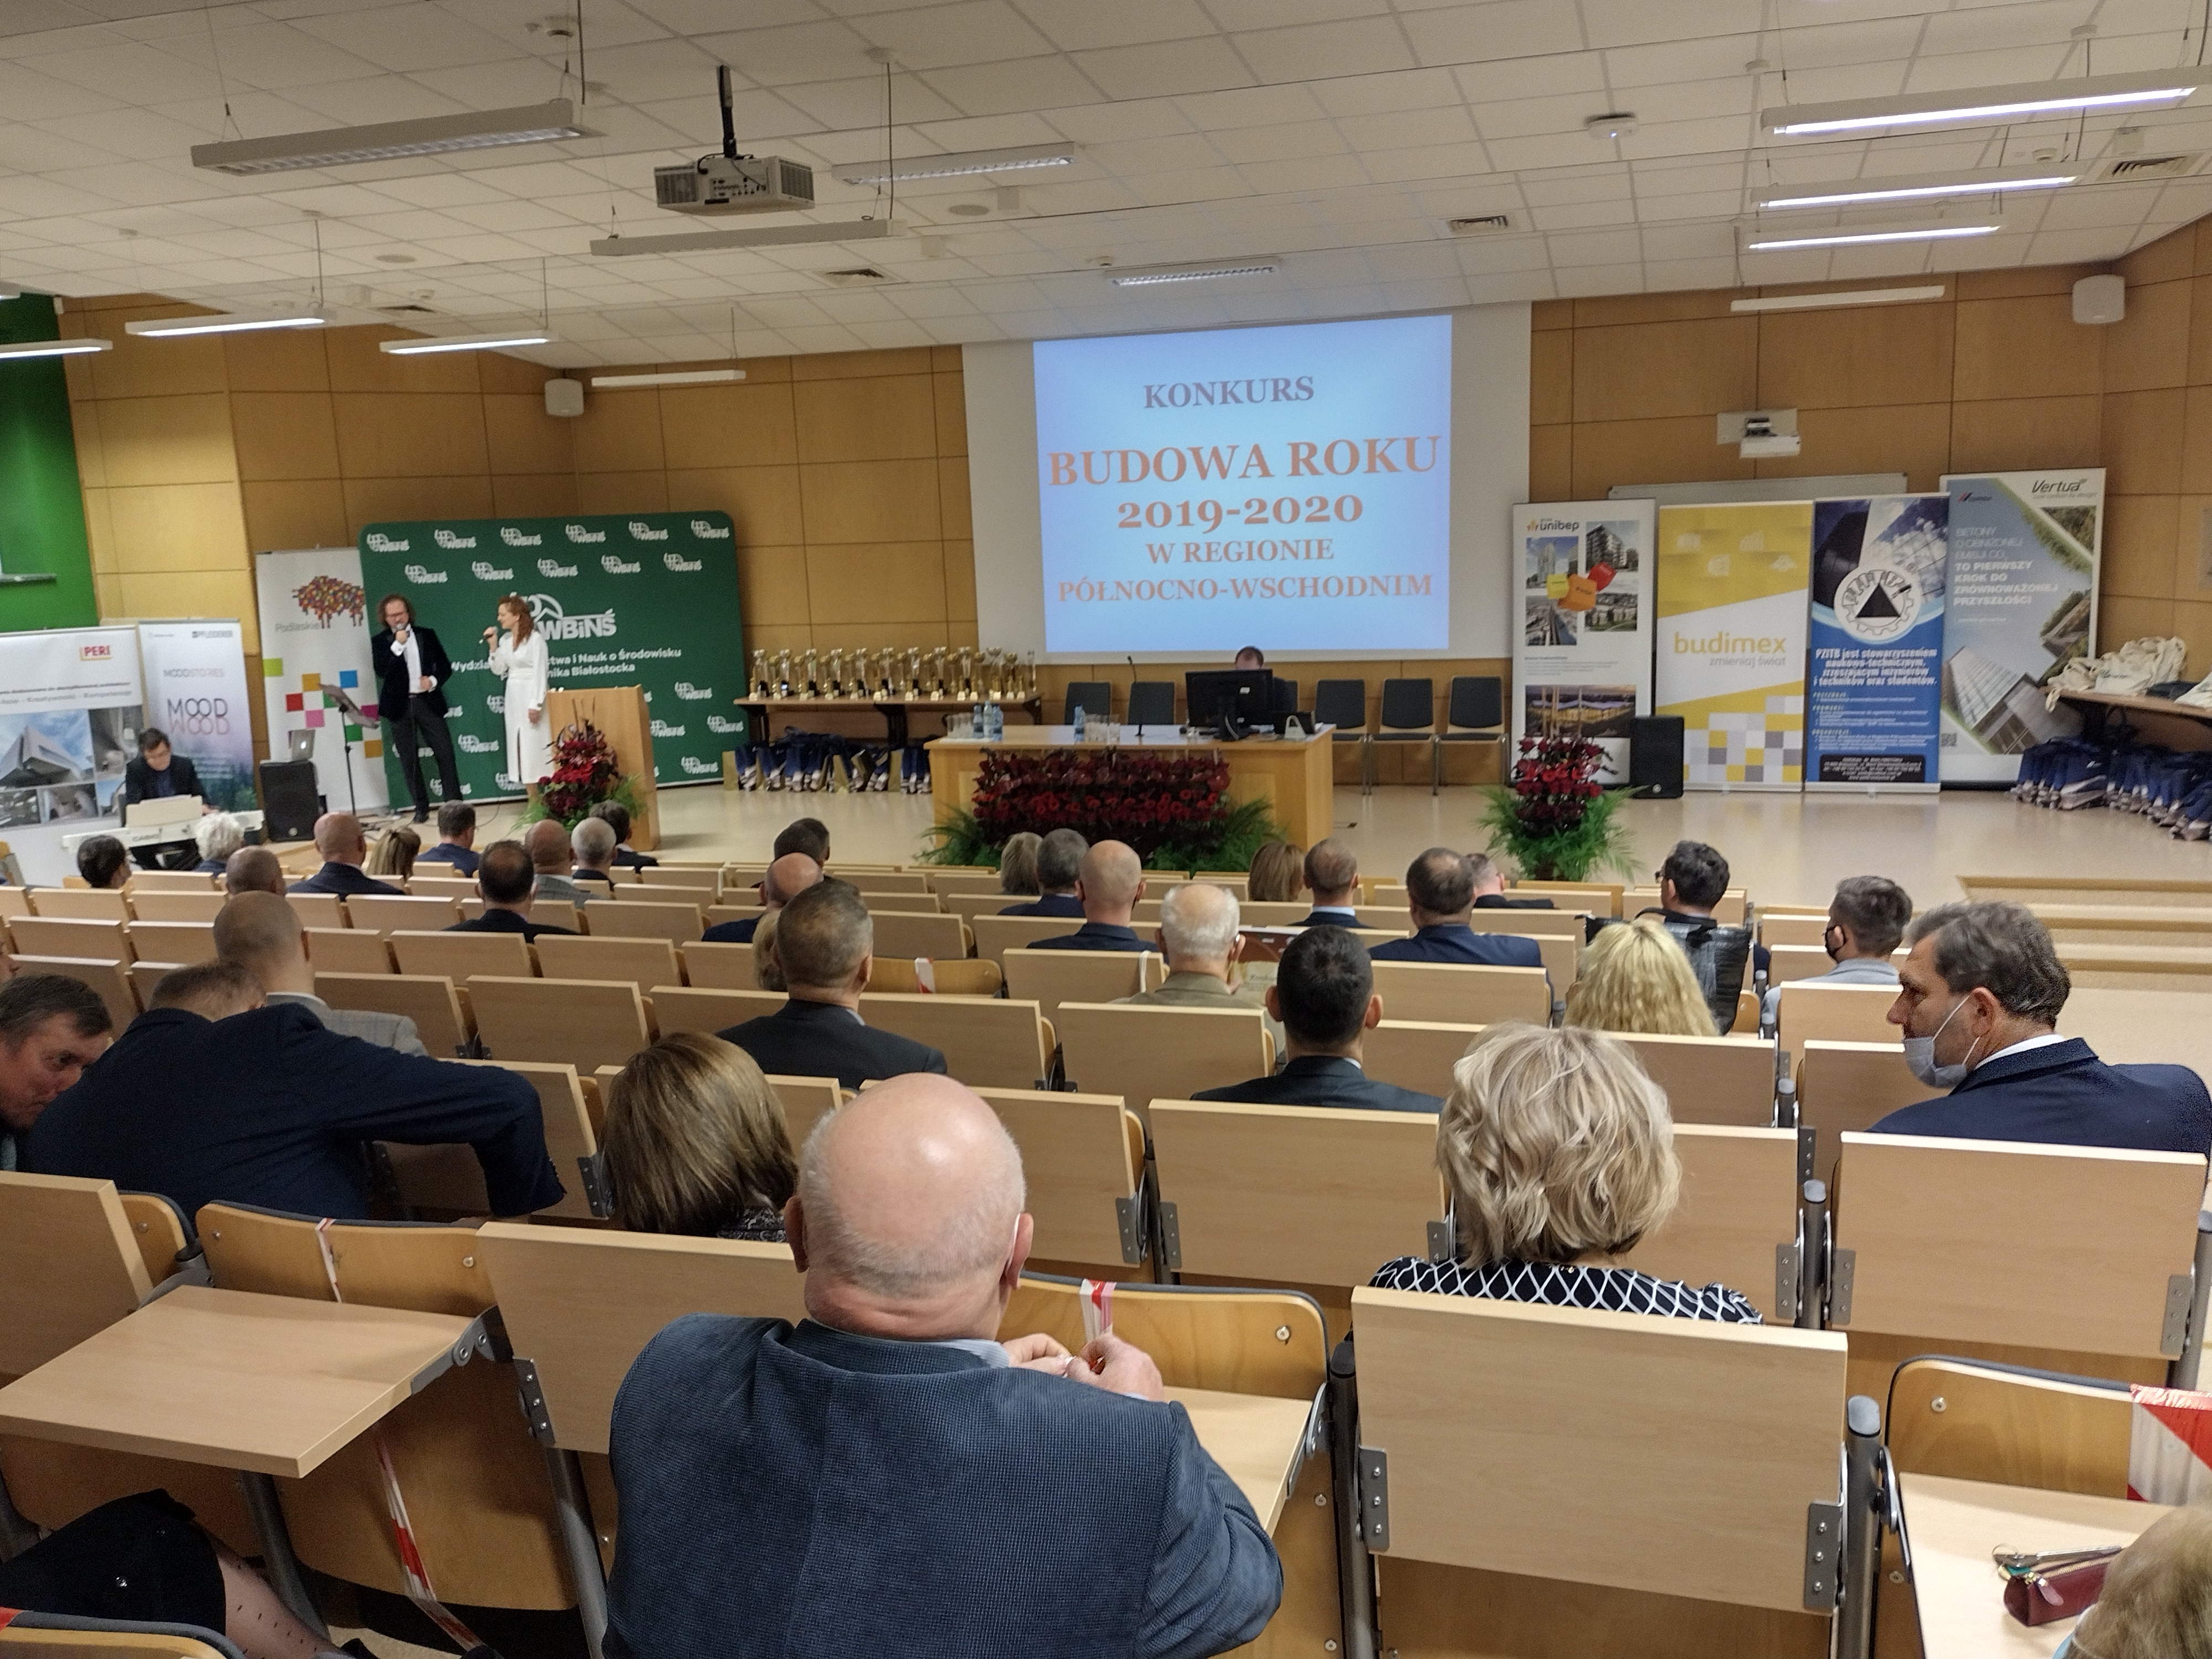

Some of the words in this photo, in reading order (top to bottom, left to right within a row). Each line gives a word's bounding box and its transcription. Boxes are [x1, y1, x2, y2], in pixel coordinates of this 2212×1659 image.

[1144, 376, 1314, 408] KONKURS
[1047, 444, 1275, 486] BUDOWA
[1286, 435, 1442, 477] ROKU
[2031, 479, 2081, 493] Vertua
[1118, 495, 1363, 534] 2019-2020
[1540, 520, 1579, 532] unibep
[1145, 542, 1176, 564] W
[1183, 538, 1334, 563] REGIONIE
[1954, 562, 1971, 571] TO
[1973, 560, 2034, 571] PIERWSZY
[1058, 573, 1433, 602] PÓŁNOCNO-WSCHODNIM
[1954, 573, 1988, 583] KROK
[1990, 572, 2008, 582] DO
[537, 608, 617, 640] WBiNŚ
[84, 645, 110, 656] PERI
[1673, 630, 1786, 654] budimex
[451, 659, 490, 672] Wydzia
[578, 651, 607, 664] Nauk
[609, 653, 617, 661] o
[618, 648, 682, 661] Środowisku
[1815, 648, 1840, 659] PZITB
[1842, 648, 1860, 660] jest
[571, 662, 636, 676] Białostocka
[167, 698, 228, 718] MOOD
